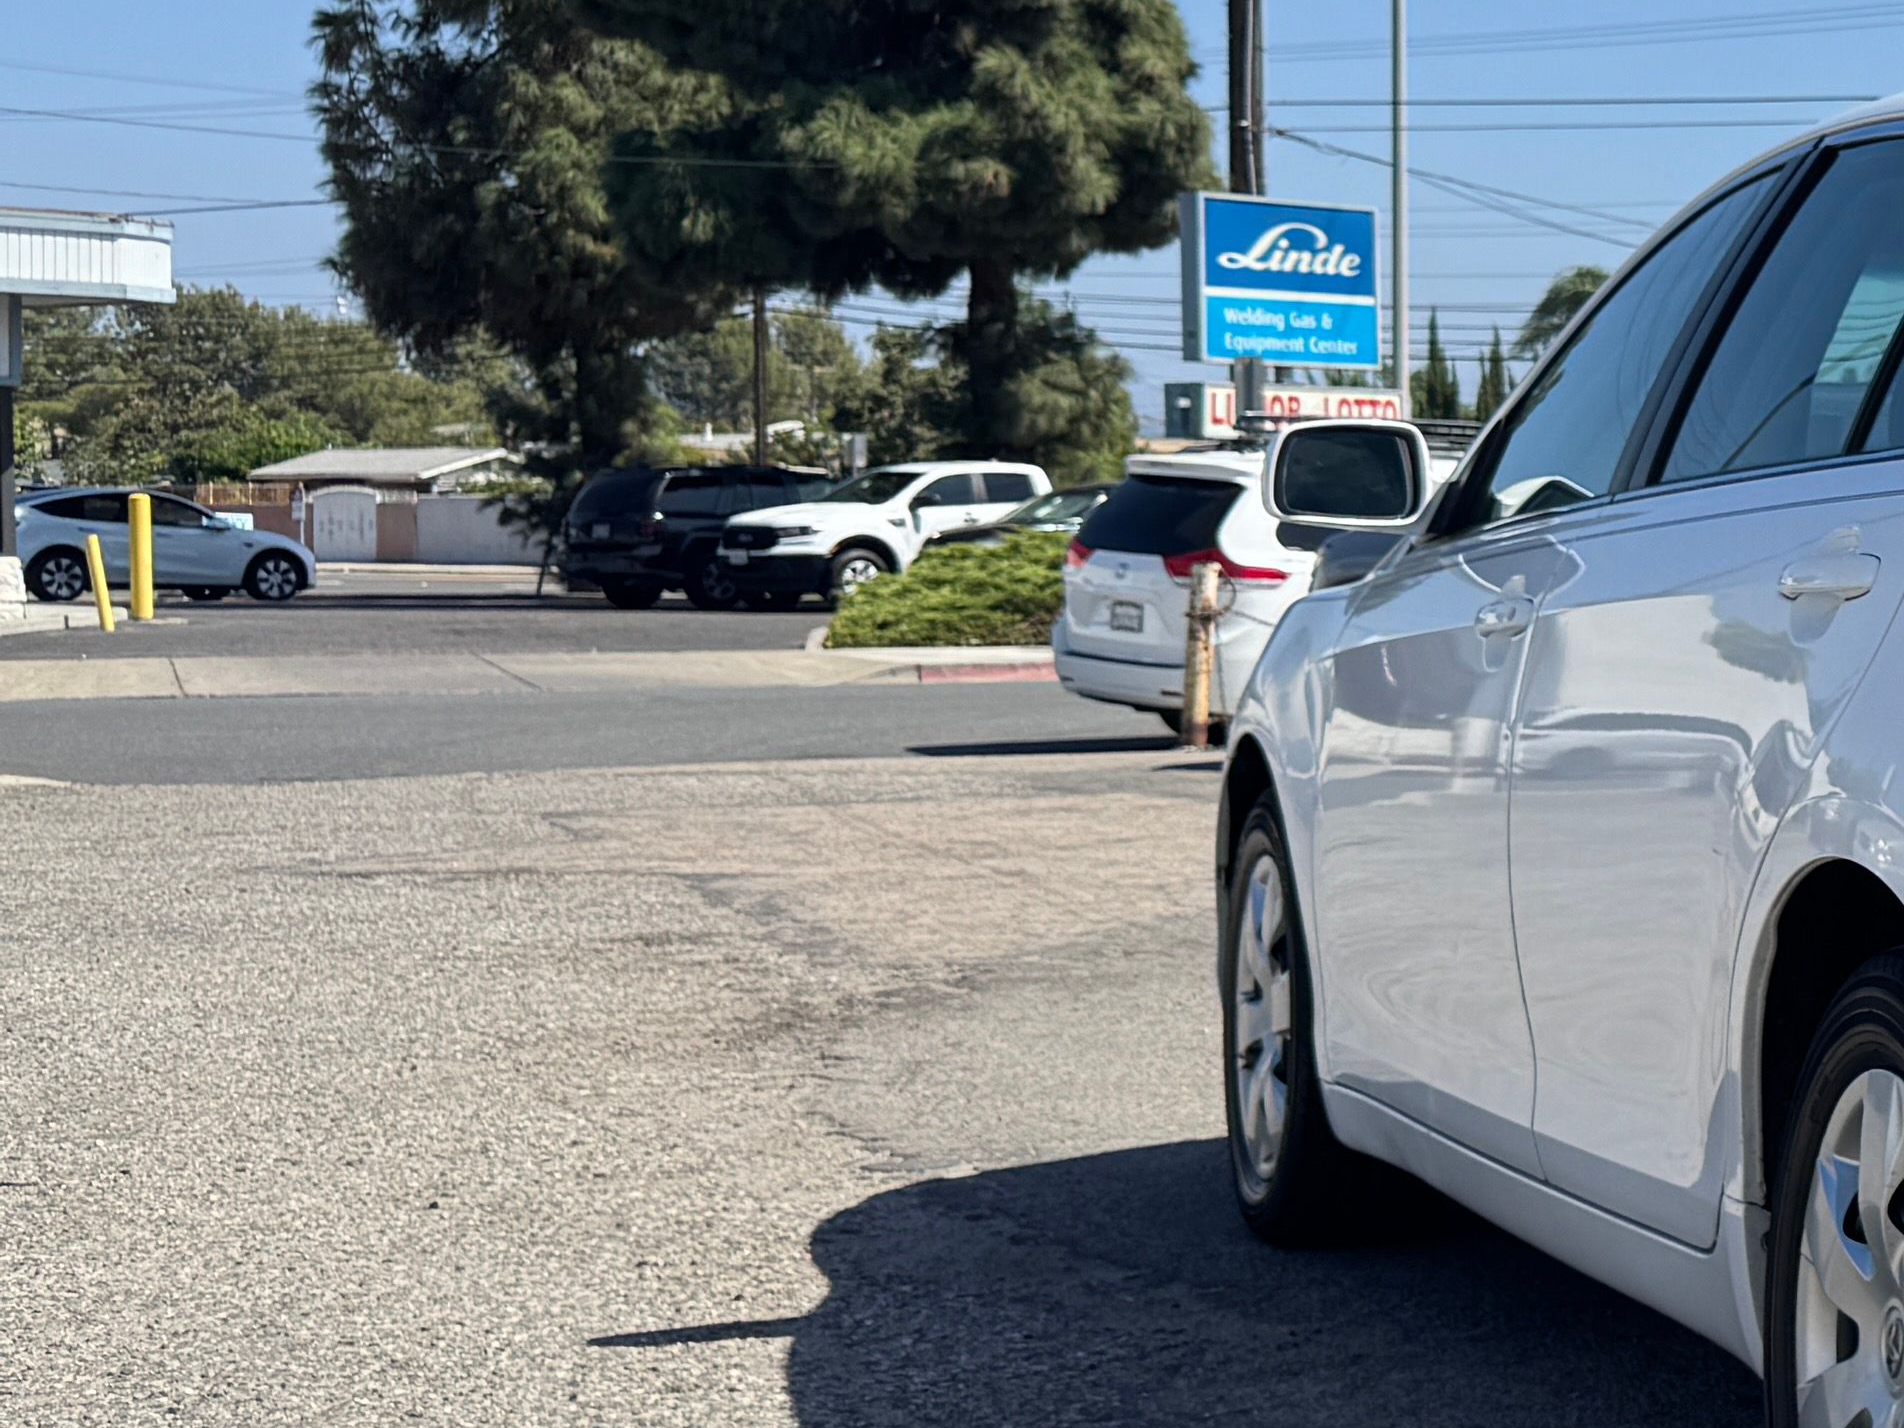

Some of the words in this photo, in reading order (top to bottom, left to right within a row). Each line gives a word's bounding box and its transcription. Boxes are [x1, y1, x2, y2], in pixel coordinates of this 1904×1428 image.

[1216, 222, 1361, 277] Linde
[1223, 306, 1285, 331] Welding
[1289, 312, 1317, 329] Gas
[1321, 313, 1333, 330] &
[1224, 332, 1304, 356] Equipment
[1309, 337, 1357, 355] Center
[1211, 392, 1299, 425] LIOR
